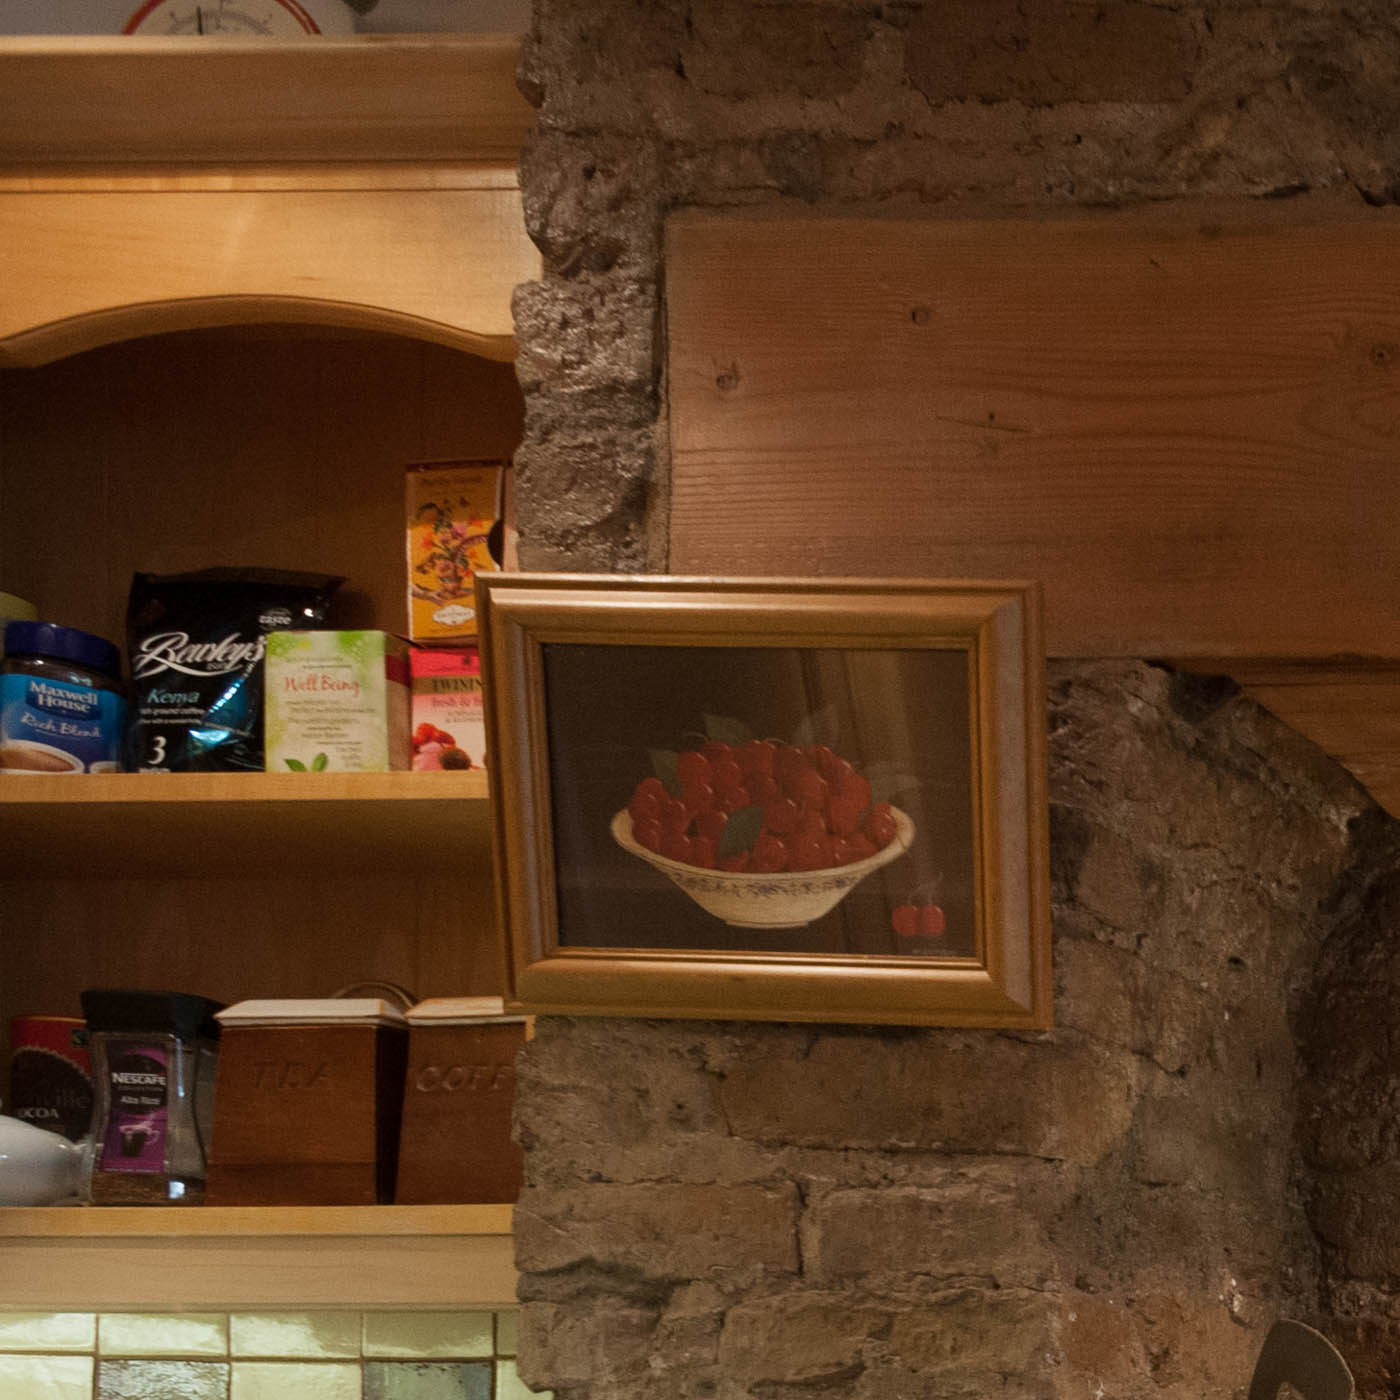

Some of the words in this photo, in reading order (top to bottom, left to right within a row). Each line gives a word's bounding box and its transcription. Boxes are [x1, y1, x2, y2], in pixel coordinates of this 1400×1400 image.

[29, 680, 99, 706] Maxwell
[147, 688, 200, 707] Kenya
[321, 674, 360, 698] Being
[37, 694, 90, 714] House
[20, 711, 56, 732] Rich
[59, 721, 102, 738] Blend
[149, 735, 168, 766] 3
[254, 1061, 330, 1090] TEA
